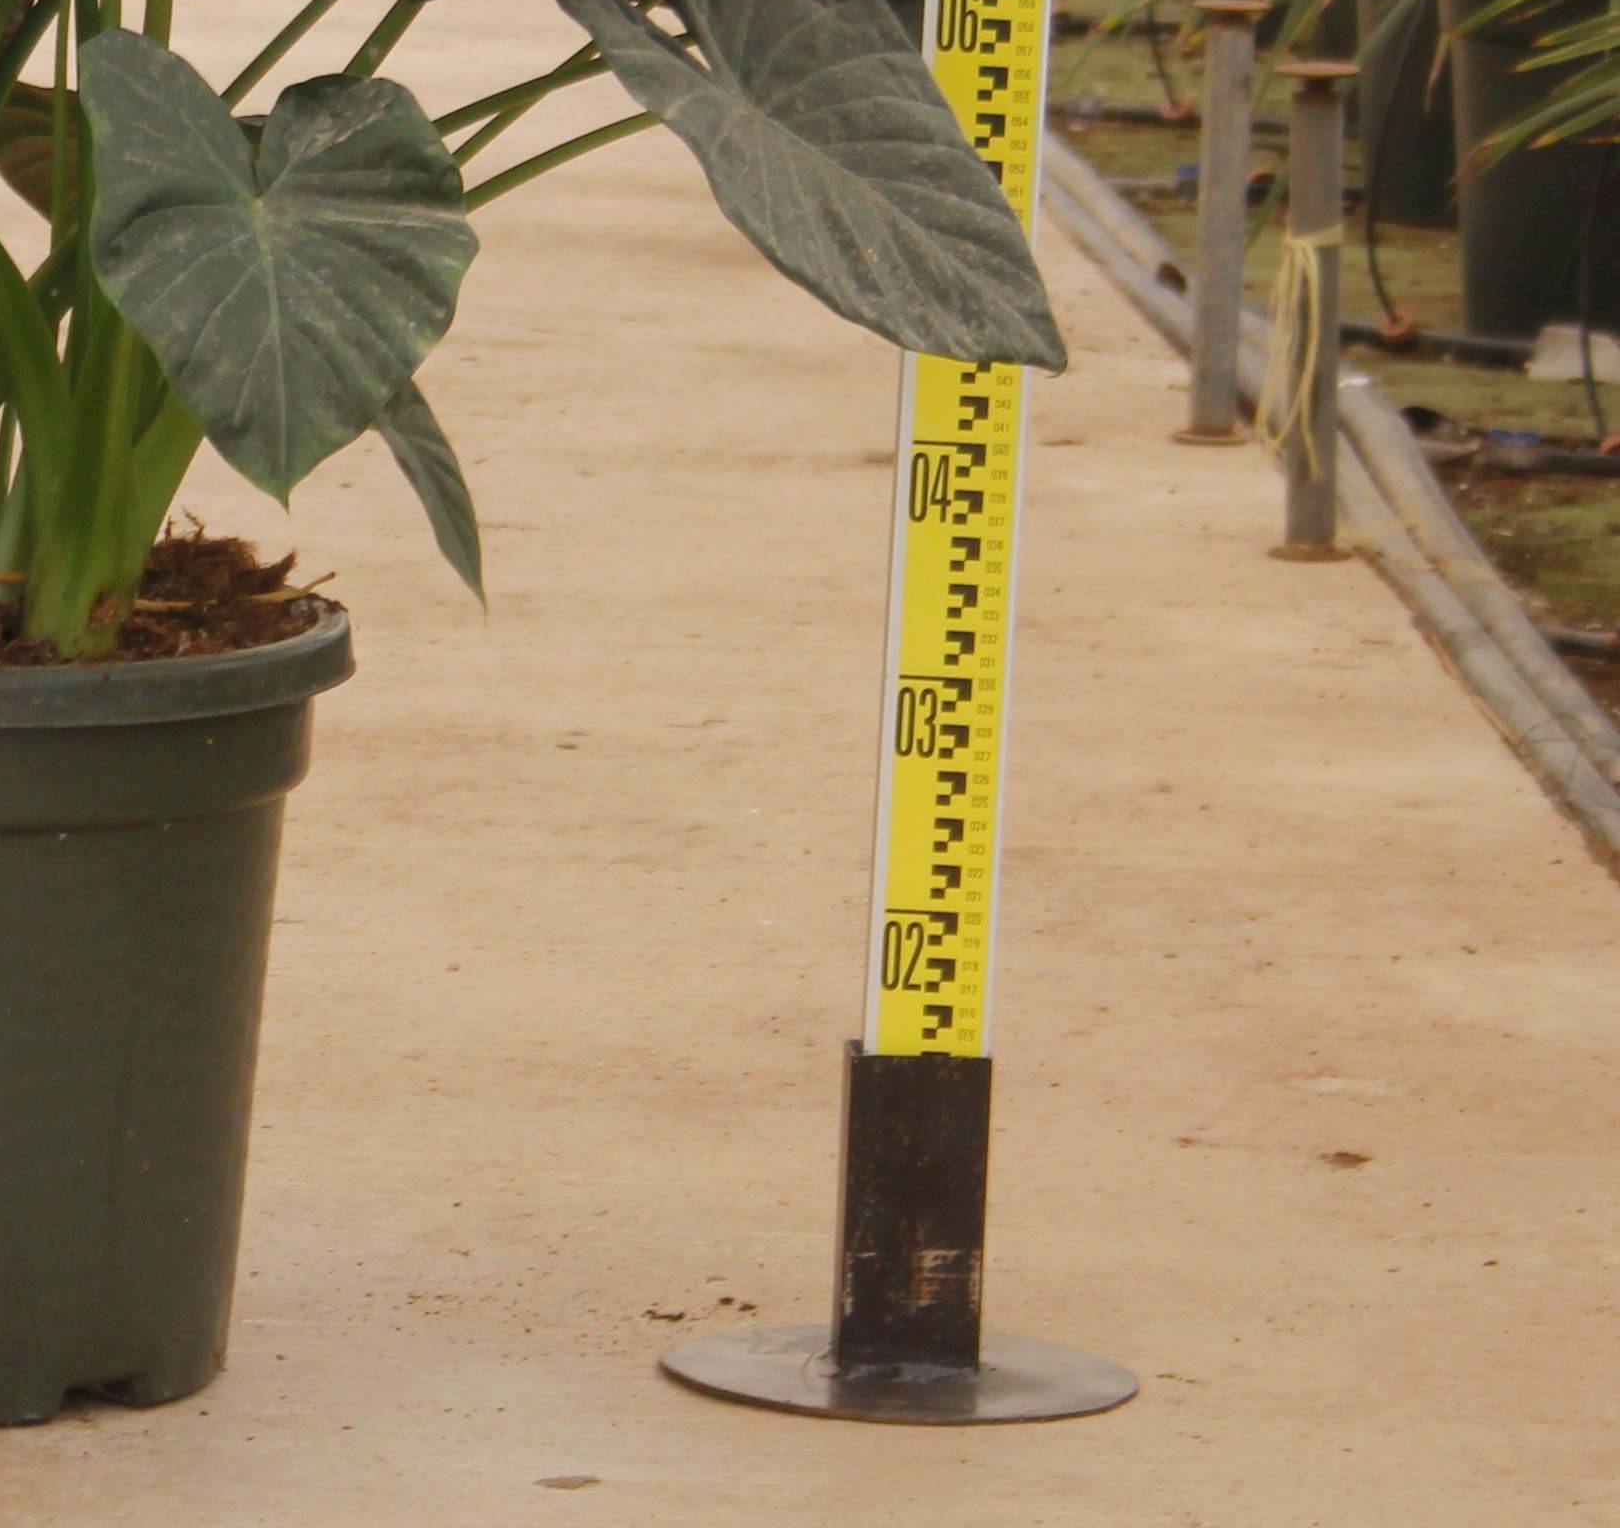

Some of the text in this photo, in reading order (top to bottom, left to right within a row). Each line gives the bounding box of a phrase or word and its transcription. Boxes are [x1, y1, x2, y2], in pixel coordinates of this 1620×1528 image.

[909, 452, 951, 523] 04
[895, 687, 938, 758] 03
[882, 921, 924, 991] 02
